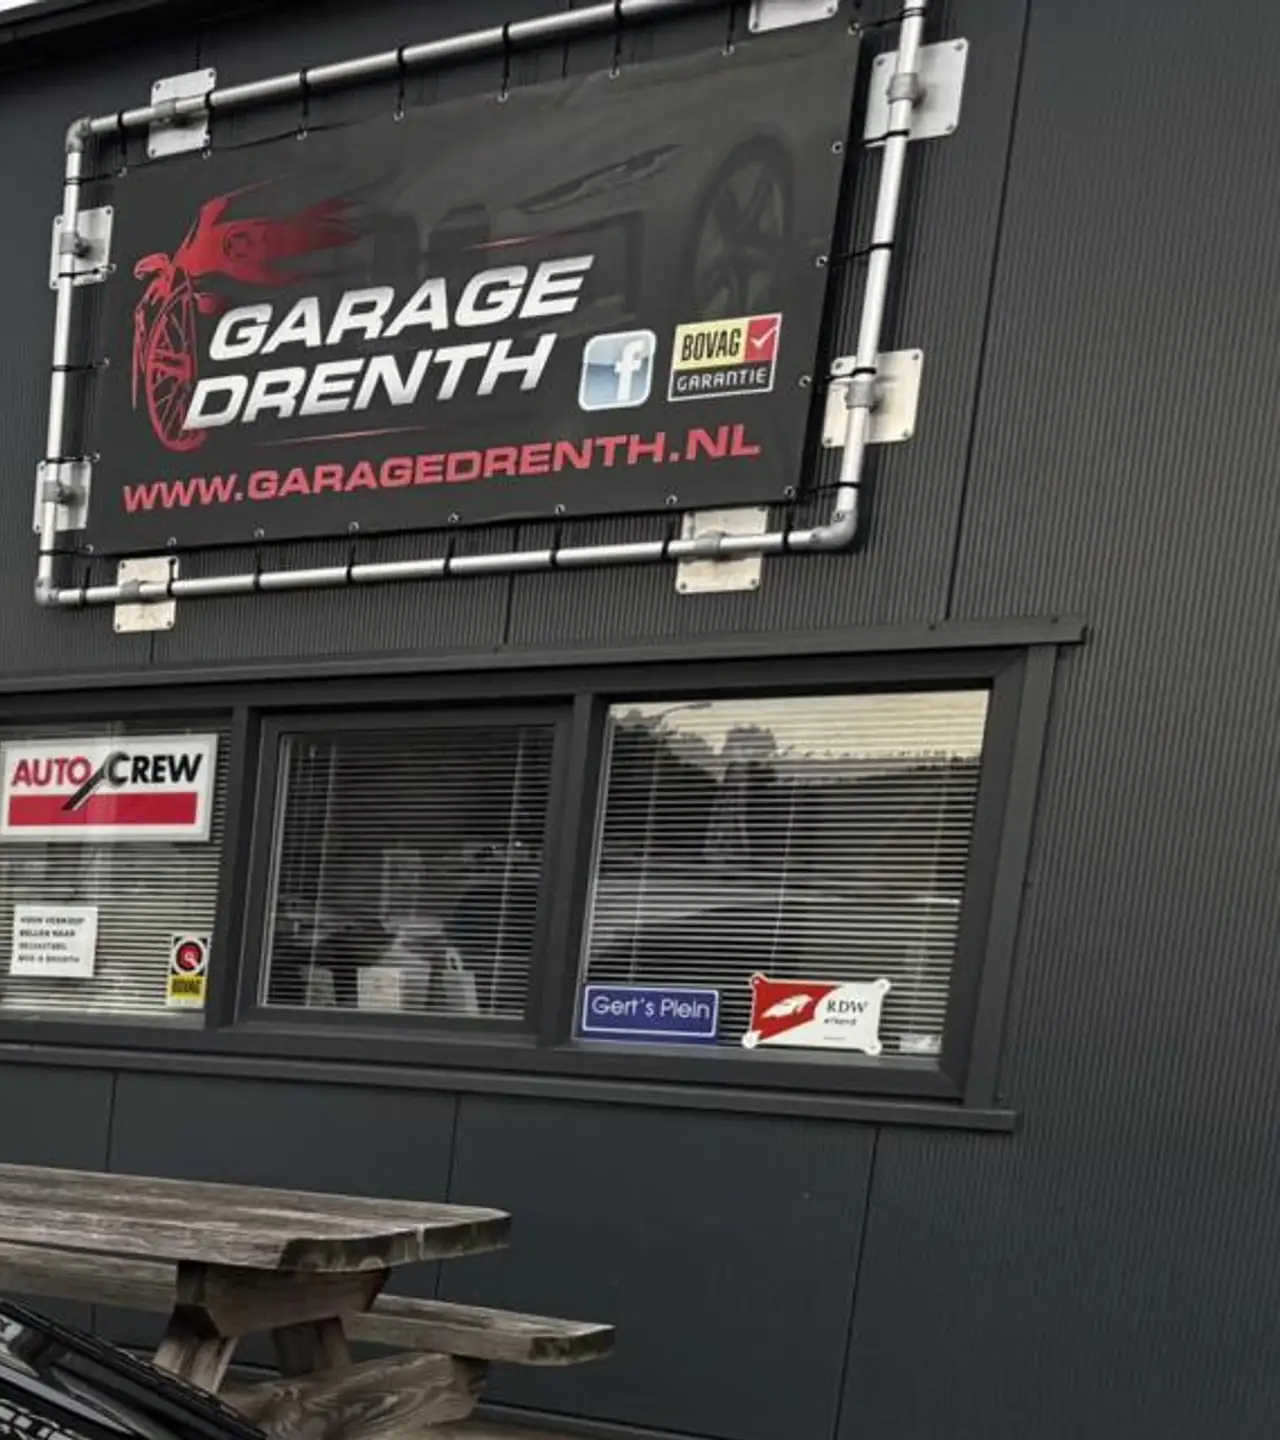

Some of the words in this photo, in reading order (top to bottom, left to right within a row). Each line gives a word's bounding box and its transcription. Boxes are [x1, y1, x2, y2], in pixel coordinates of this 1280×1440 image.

[208, 255, 594, 361] GARAGE
[681, 327, 742, 361] BOVAG
[182, 334, 557, 430] DRENTH
[676, 366, 768, 393] GARANTIE
[123, 423, 761, 513] WWW.GARAGEDRENTH.NL
[11, 756, 92, 788] AUTO
[107, 751, 204, 788] CREW
[591, 996, 656, 1018] Gert's
[659, 997, 711, 1019] Plein
[826, 1000, 870, 1014] RDW
